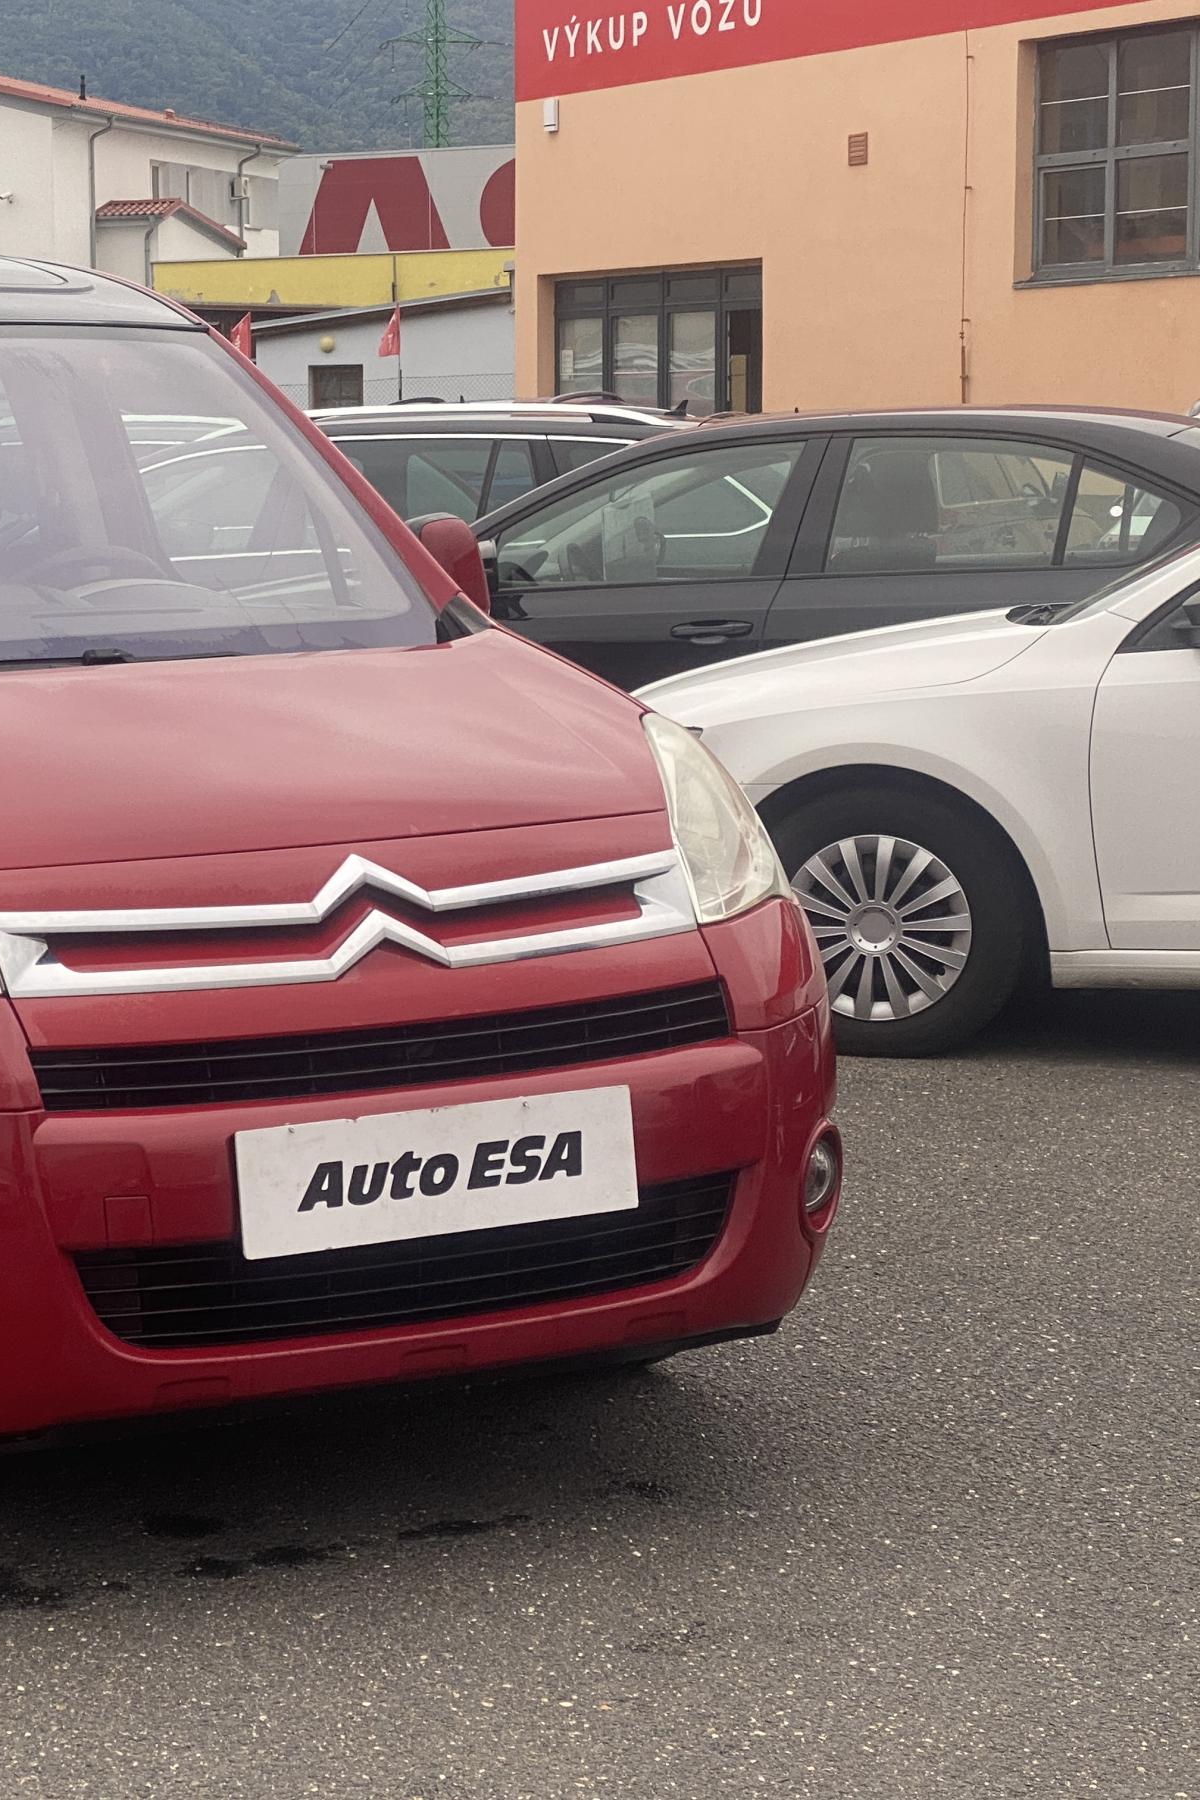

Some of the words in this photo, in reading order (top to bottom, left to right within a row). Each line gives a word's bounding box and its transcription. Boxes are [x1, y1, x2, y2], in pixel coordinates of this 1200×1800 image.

[542, 11, 648, 62] VÝKUP
[297, 1151, 460, 1213] Auto
[467, 1130, 583, 1191] ESA
